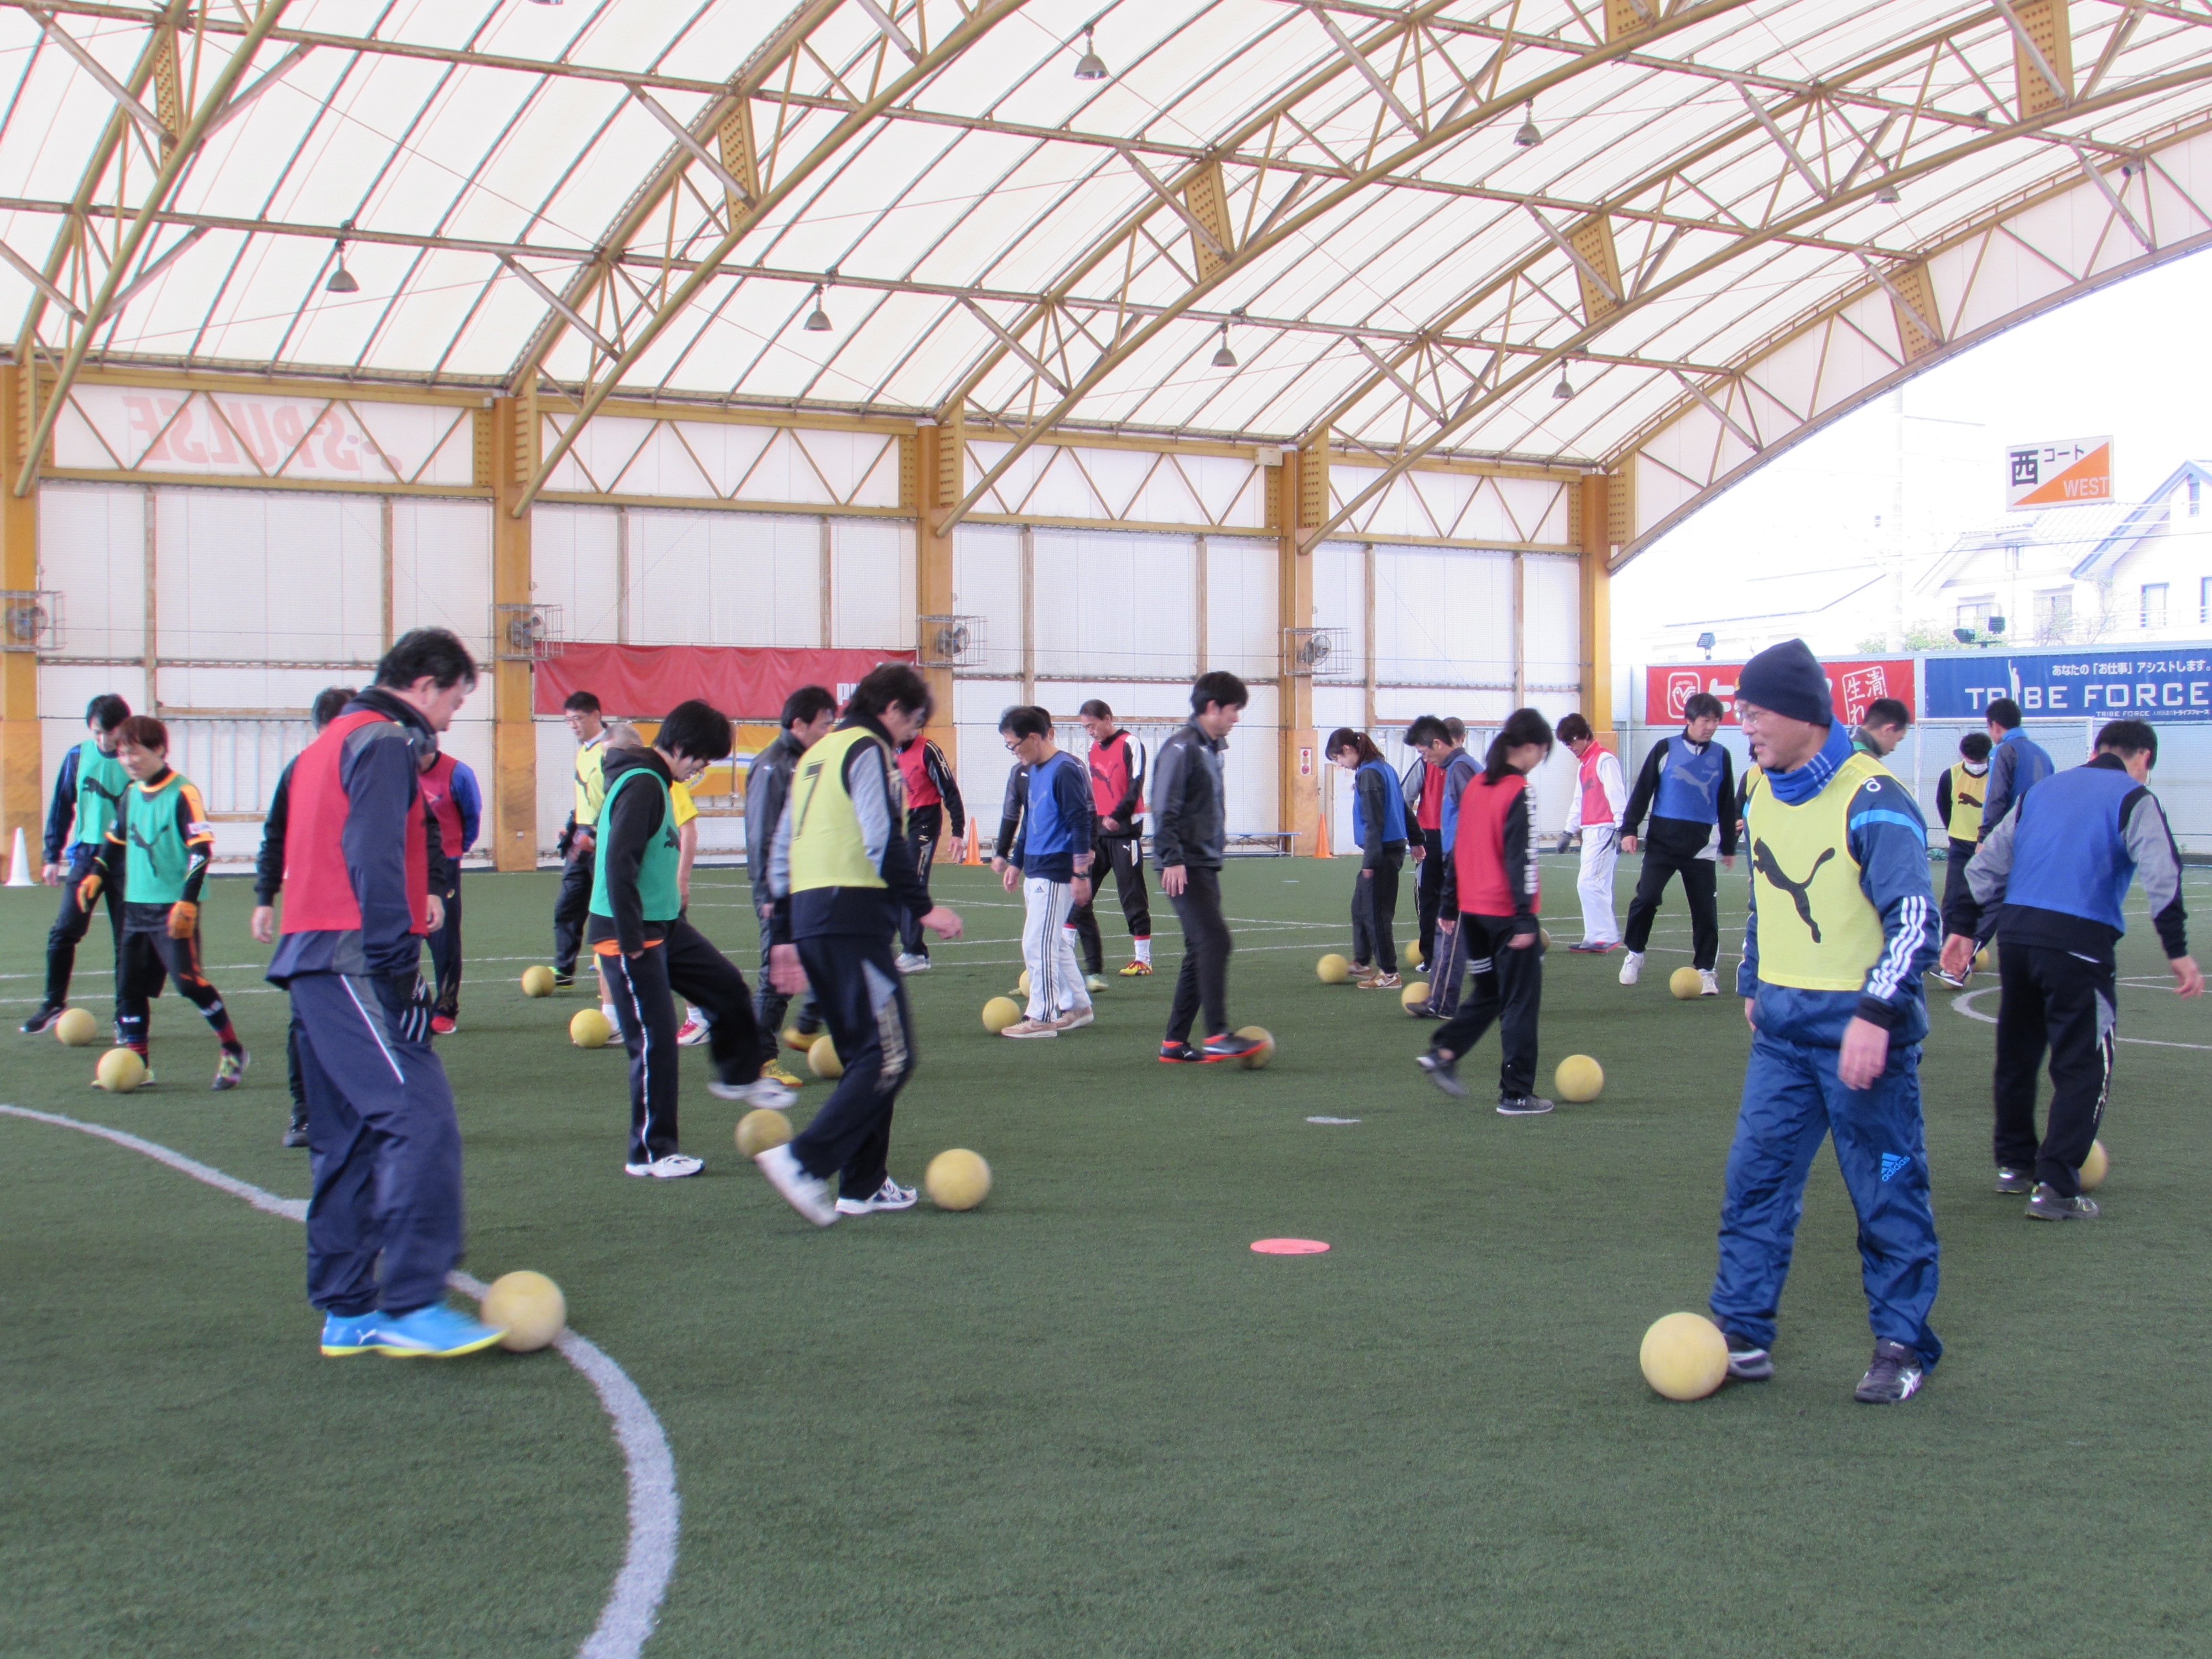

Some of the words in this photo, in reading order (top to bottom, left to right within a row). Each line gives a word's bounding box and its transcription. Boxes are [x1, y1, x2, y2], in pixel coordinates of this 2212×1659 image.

[2063, 476, 2110, 498] WEST
[2084, 682, 2210, 708] FORCE
[793, 758, 828, 841] 7
[1882, 1156, 1911, 1182] adidas
